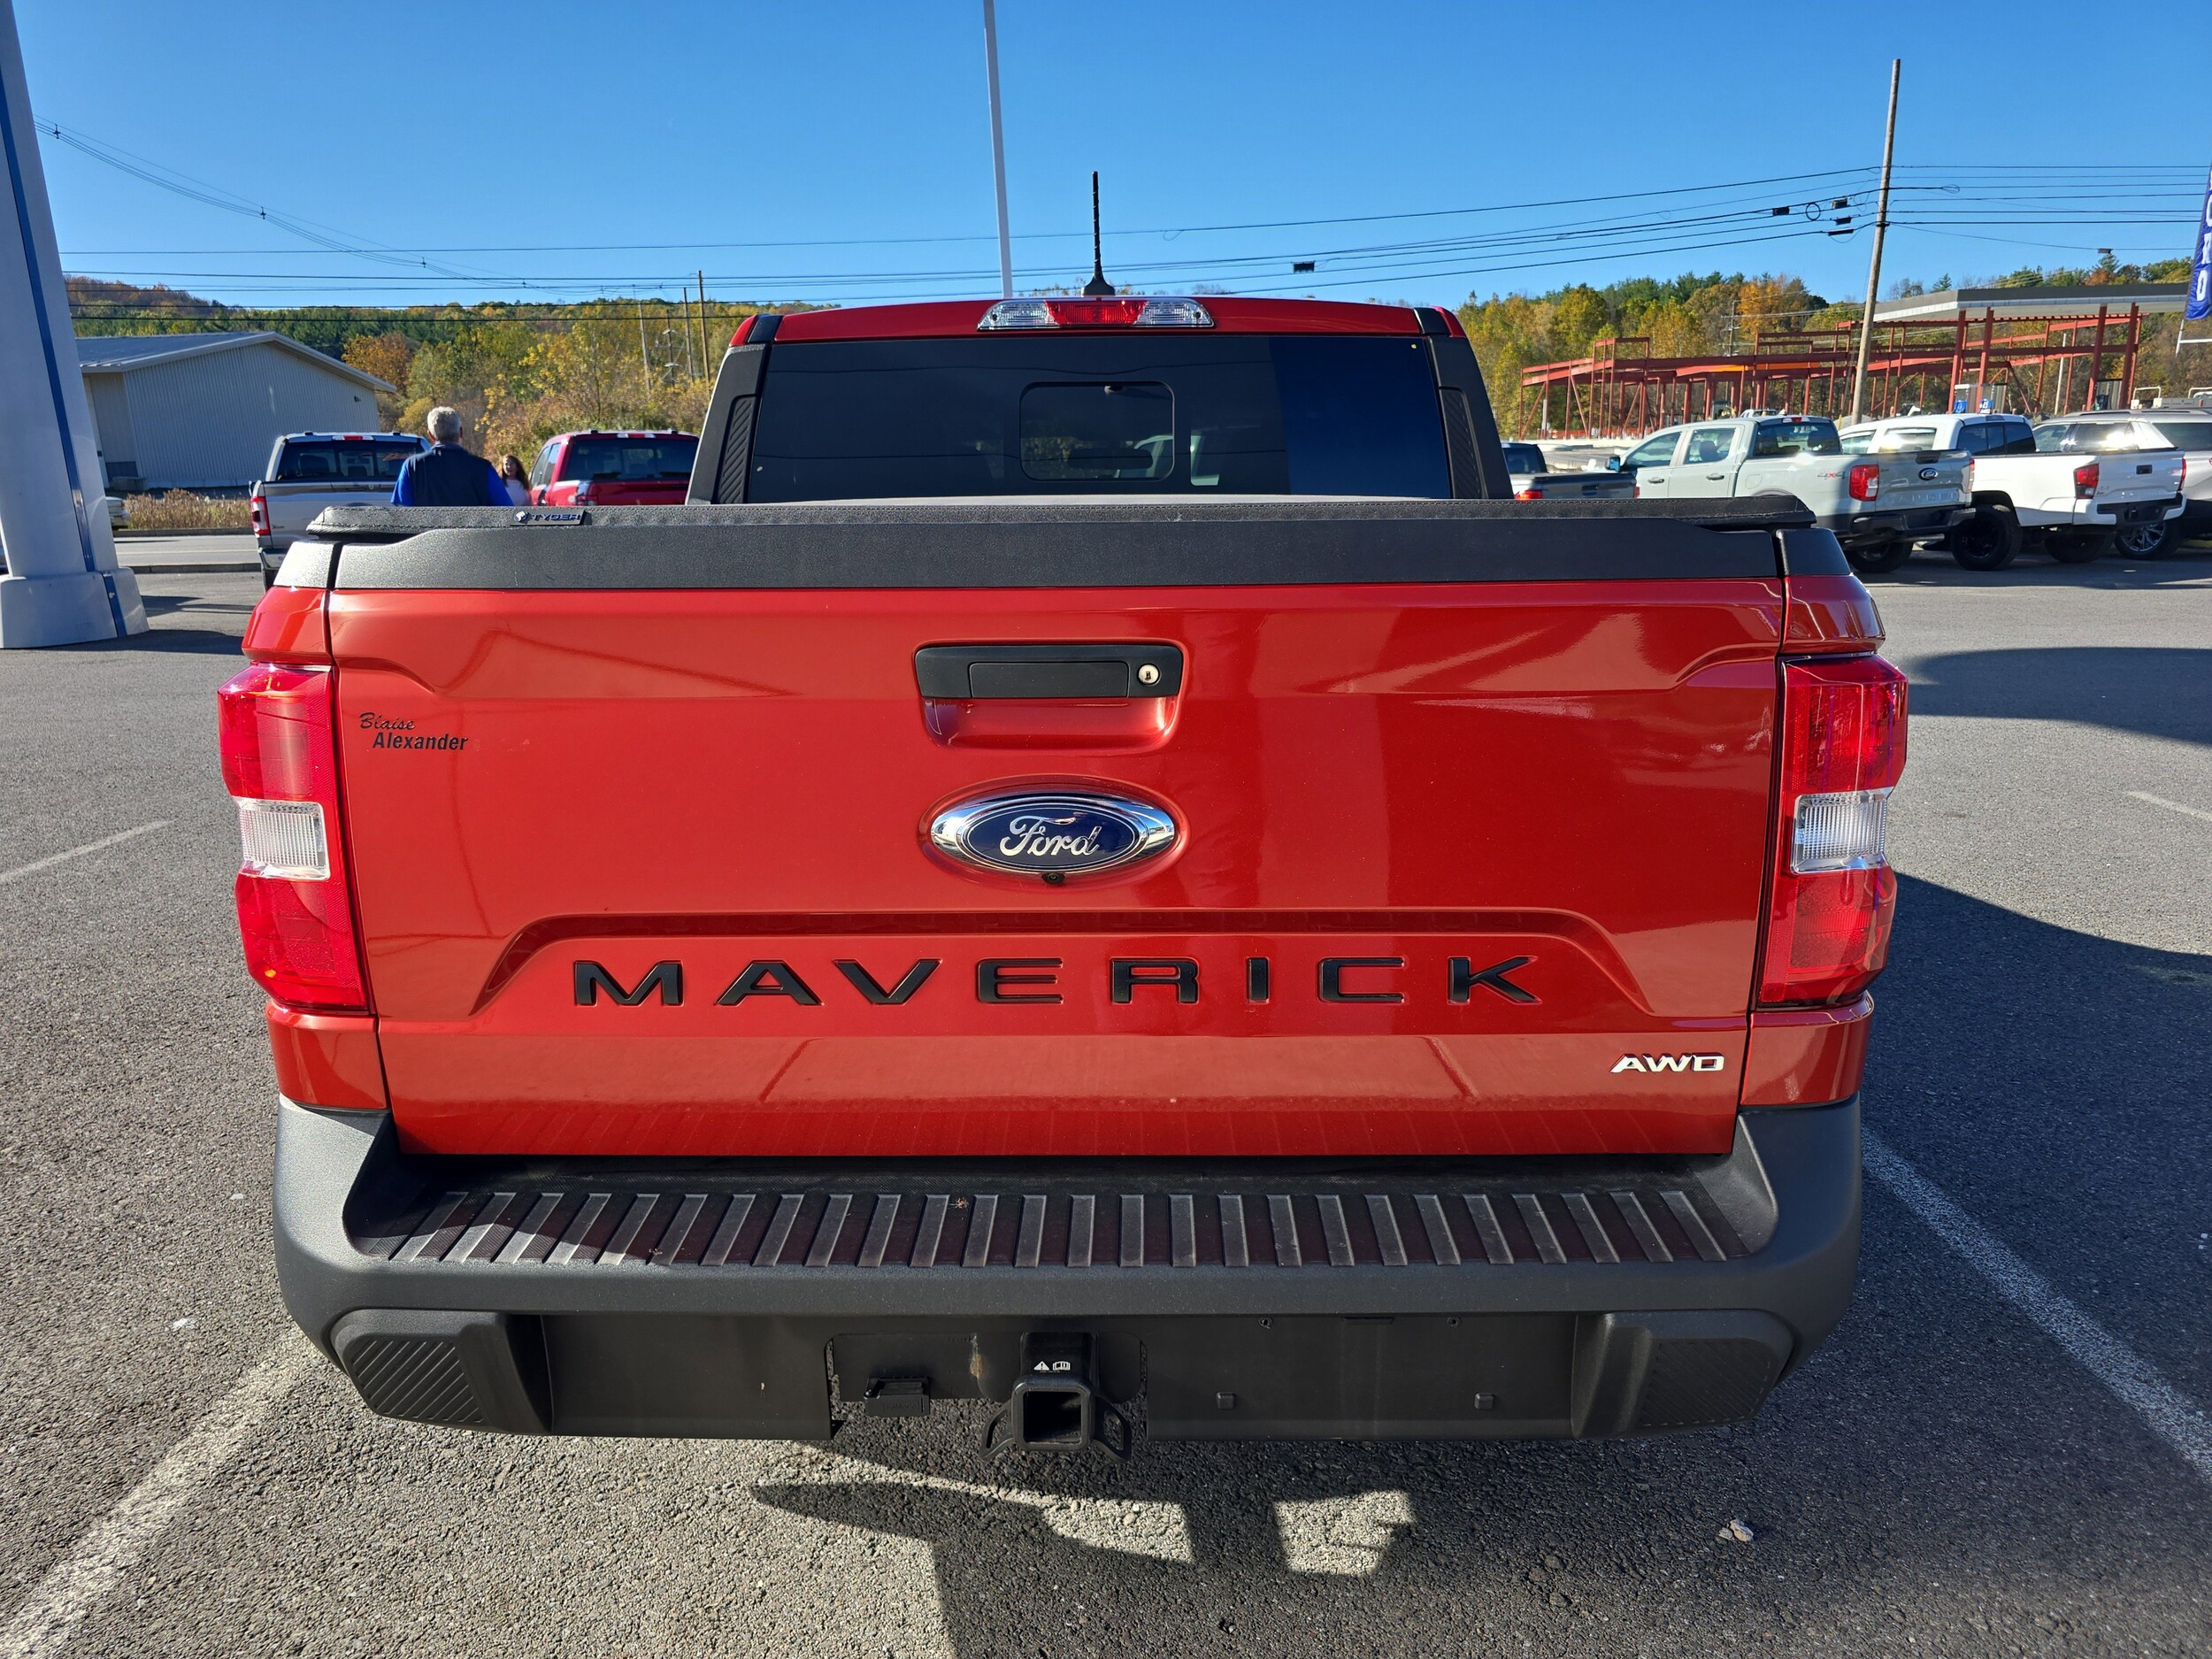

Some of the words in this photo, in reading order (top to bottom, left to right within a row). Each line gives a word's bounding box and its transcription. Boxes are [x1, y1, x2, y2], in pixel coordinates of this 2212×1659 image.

[359, 712, 415, 730] Blaise
[373, 732, 468, 750] Alexander
[1000, 815, 1102, 856] Ford
[573, 956, 1542, 1007] MAVERICK
[1609, 1052, 1724, 1072] AWD
